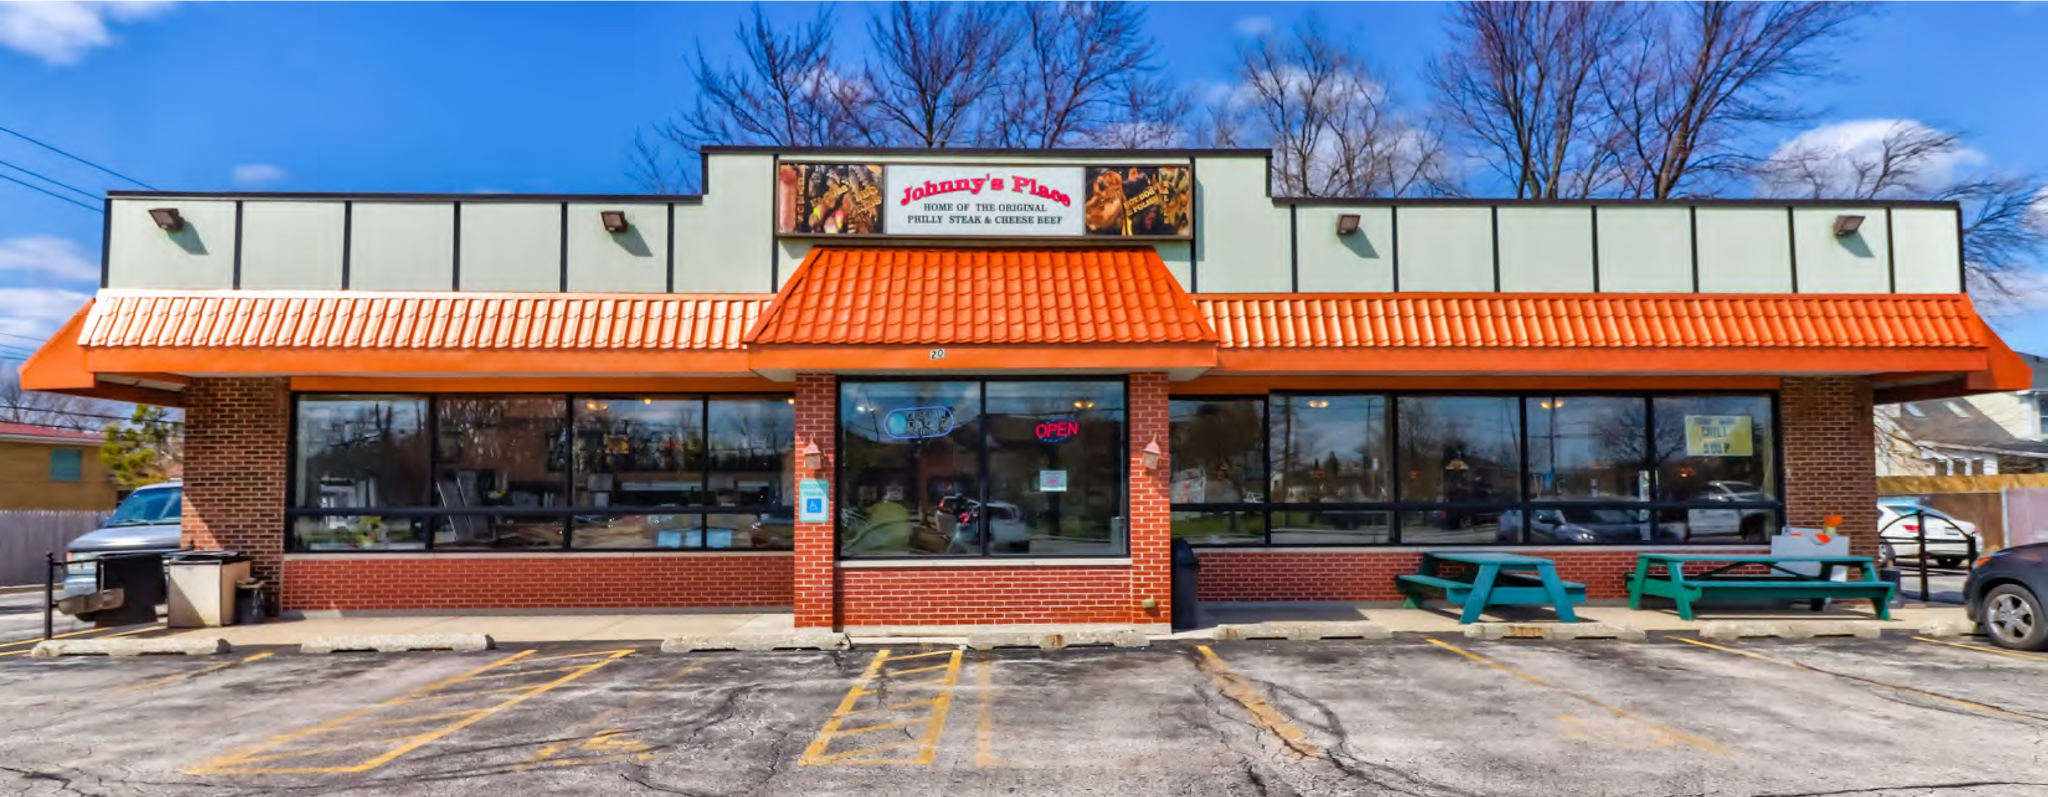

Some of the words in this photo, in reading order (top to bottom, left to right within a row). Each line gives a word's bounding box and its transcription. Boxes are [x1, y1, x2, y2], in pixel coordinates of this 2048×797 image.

[901, 173, 1004, 206] Johnny's
[1011, 175, 1071, 207] Place
[923, 203, 953, 212] HOME
[956, 203, 970, 212] OF
[976, 203, 995, 212] THE
[999, 203, 1047, 212] ORIGINAL
[907, 215, 943, 224] PHILLY
[949, 215, 981, 224] STEAK
[984, 215, 991, 224] &
[994, 215, 1034, 224] CHEESE
[1037, 215, 1063, 224] BEEF
[931, 349, 944, 359] 20
[1035, 421, 1079, 438] OPEN
